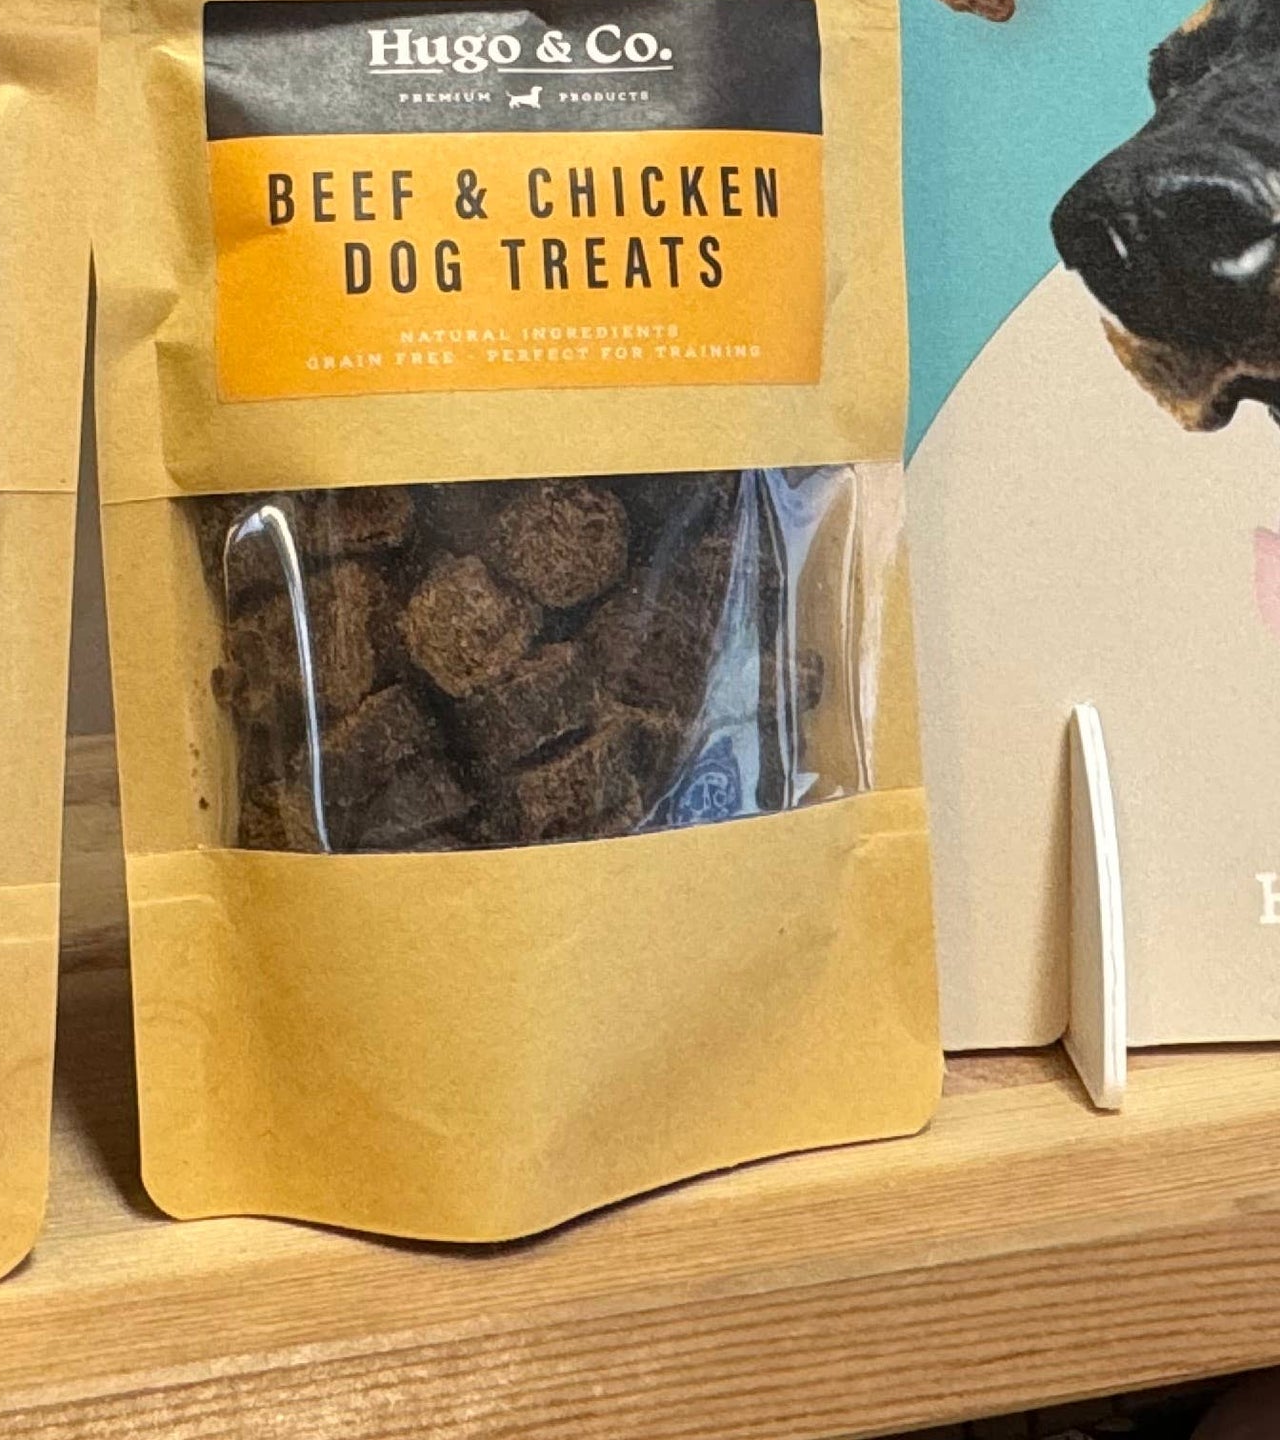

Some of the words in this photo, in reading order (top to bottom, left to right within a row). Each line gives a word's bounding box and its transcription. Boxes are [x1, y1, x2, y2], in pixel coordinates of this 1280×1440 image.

[368, 28, 521, 73] Hugo
[535, 30, 573, 63] &
[585, 23, 673, 64] Co.
[399, 92, 492, 104] PREMIUM
[558, 90, 650, 103] PRODUCTS
[268, 170, 413, 227] BEEF
[455, 168, 489, 220] &
[528, 165, 780, 219] CHICKEN
[345, 239, 462, 295] DOG
[500, 235, 723, 291] TREATS
[400, 328, 510, 343] NATURAL
[523, 324, 679, 341] INGREDIENTS
[306, 352, 382, 371] GRAIN
[396, 350, 455, 366] FREE
[486, 347, 589, 363] PERFECT
[601, 346, 643, 361] FOR
[656, 344, 762, 360] TRAINING
